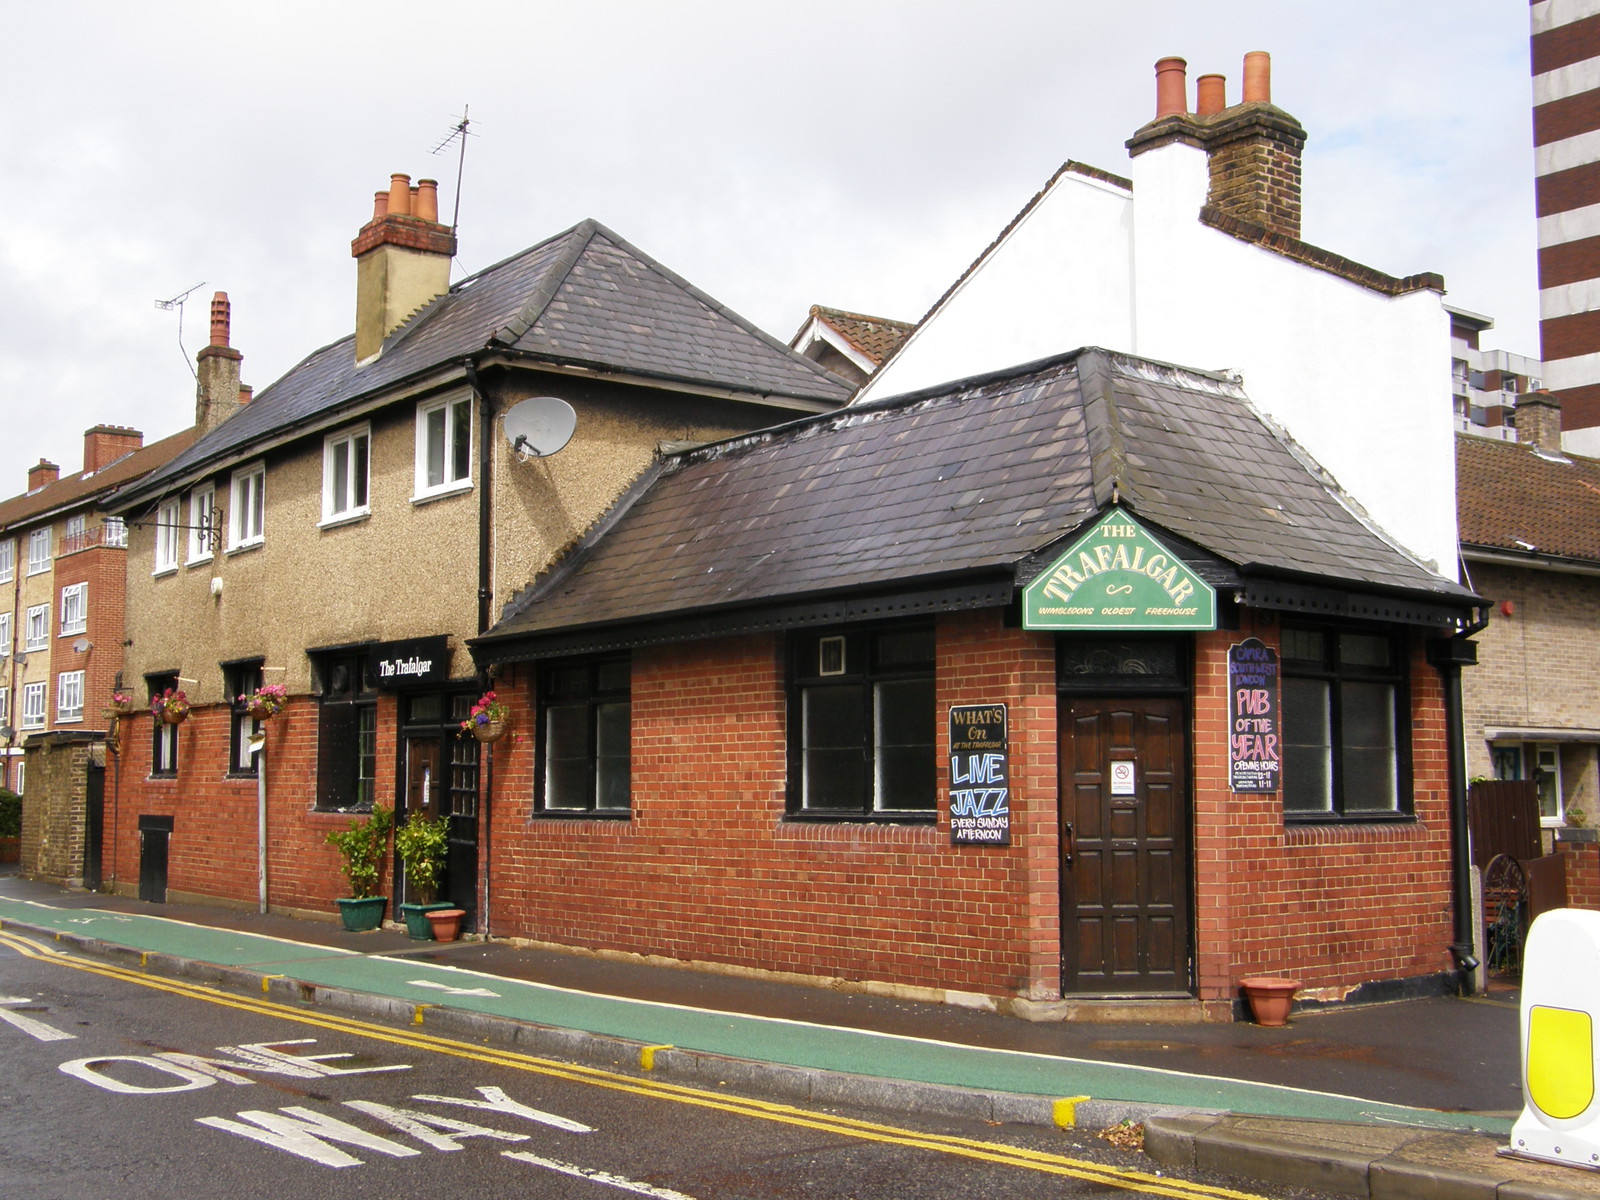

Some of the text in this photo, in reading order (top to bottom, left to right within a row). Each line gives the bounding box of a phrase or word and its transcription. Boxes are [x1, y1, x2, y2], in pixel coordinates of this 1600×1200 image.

[1100, 524, 1137, 538] THE
[1042, 543, 1195, 607] TRAFALGAR
[1038, 607, 1199, 616] WIMBLEDONS OLDEST FREEHOUSE
[1236, 647, 1269, 662] CAMRA
[379, 656, 432, 677] The Trafalgar
[1236, 674, 1266, 686] LONDON
[1236, 688, 1270, 715] PUB
[953, 708, 1003, 725] WHAT'S
[968, 726, 988, 741] On
[1235, 718, 1272, 733] OF THE
[1231, 733, 1279, 761] YEAR
[951, 753, 1005, 784] LIVE
[1233, 760, 1279, 772] OPENING HOURS
[949, 788, 1009, 817] JAZZ
[951, 816, 1009, 829] EVERY SUNDAY
[956, 828, 1002, 840] AFTERNOON
[57, 1038, 414, 1095] ONE
[193, 1085, 600, 1168] WAY
